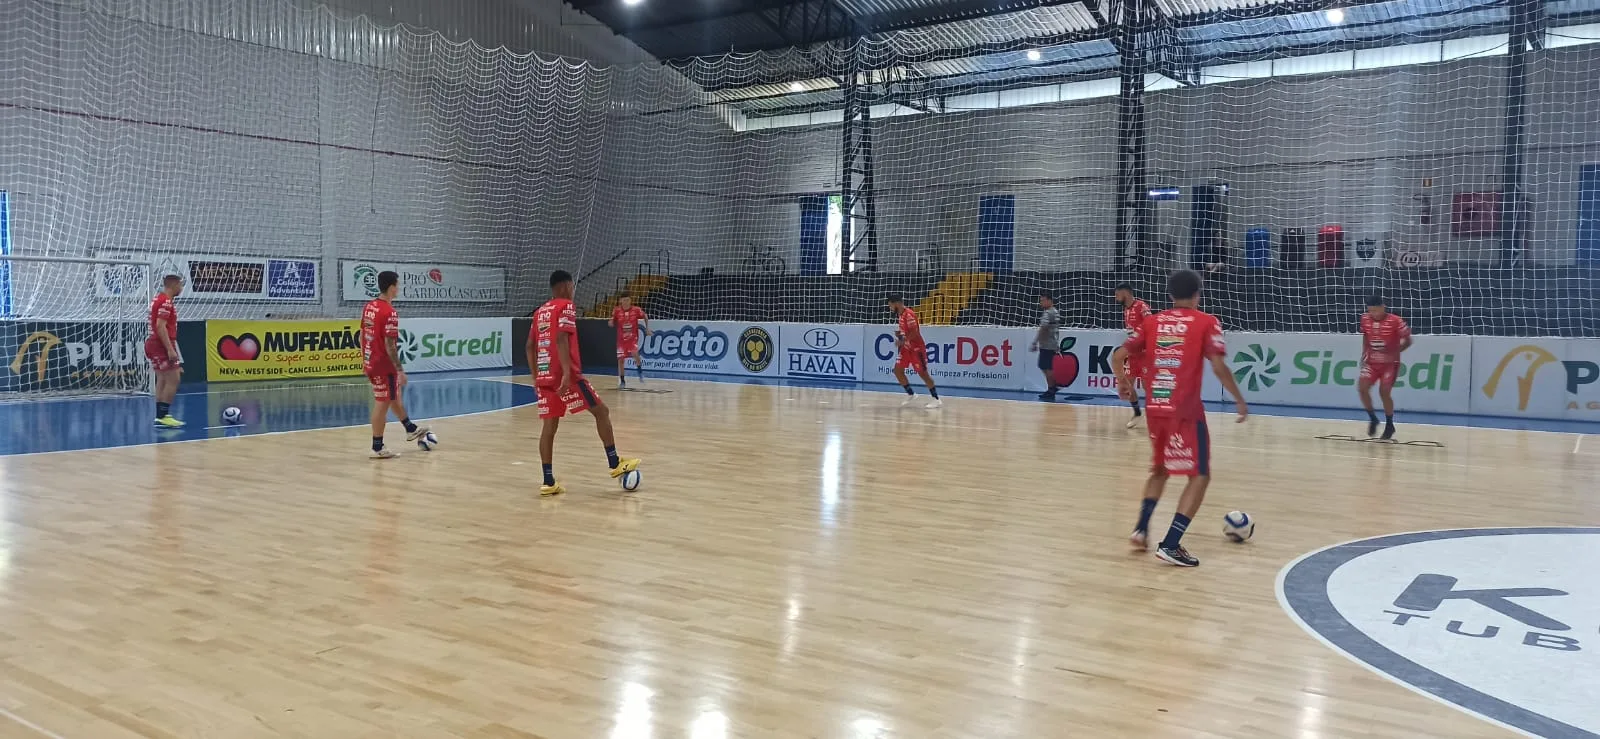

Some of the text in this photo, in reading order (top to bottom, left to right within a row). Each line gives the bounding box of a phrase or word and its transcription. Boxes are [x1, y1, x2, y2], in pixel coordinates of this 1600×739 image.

[420, 331, 503, 358] Sicredi
[874, 333, 1012, 367] CarDet
[288, 366, 322, 374] CANCELLI
[788, 352, 855, 375] HAVAN
[930, 369, 960, 377] Limpeza
[963, 370, 1010, 379] Profissional
[1290, 349, 1455, 391] Sicdi
